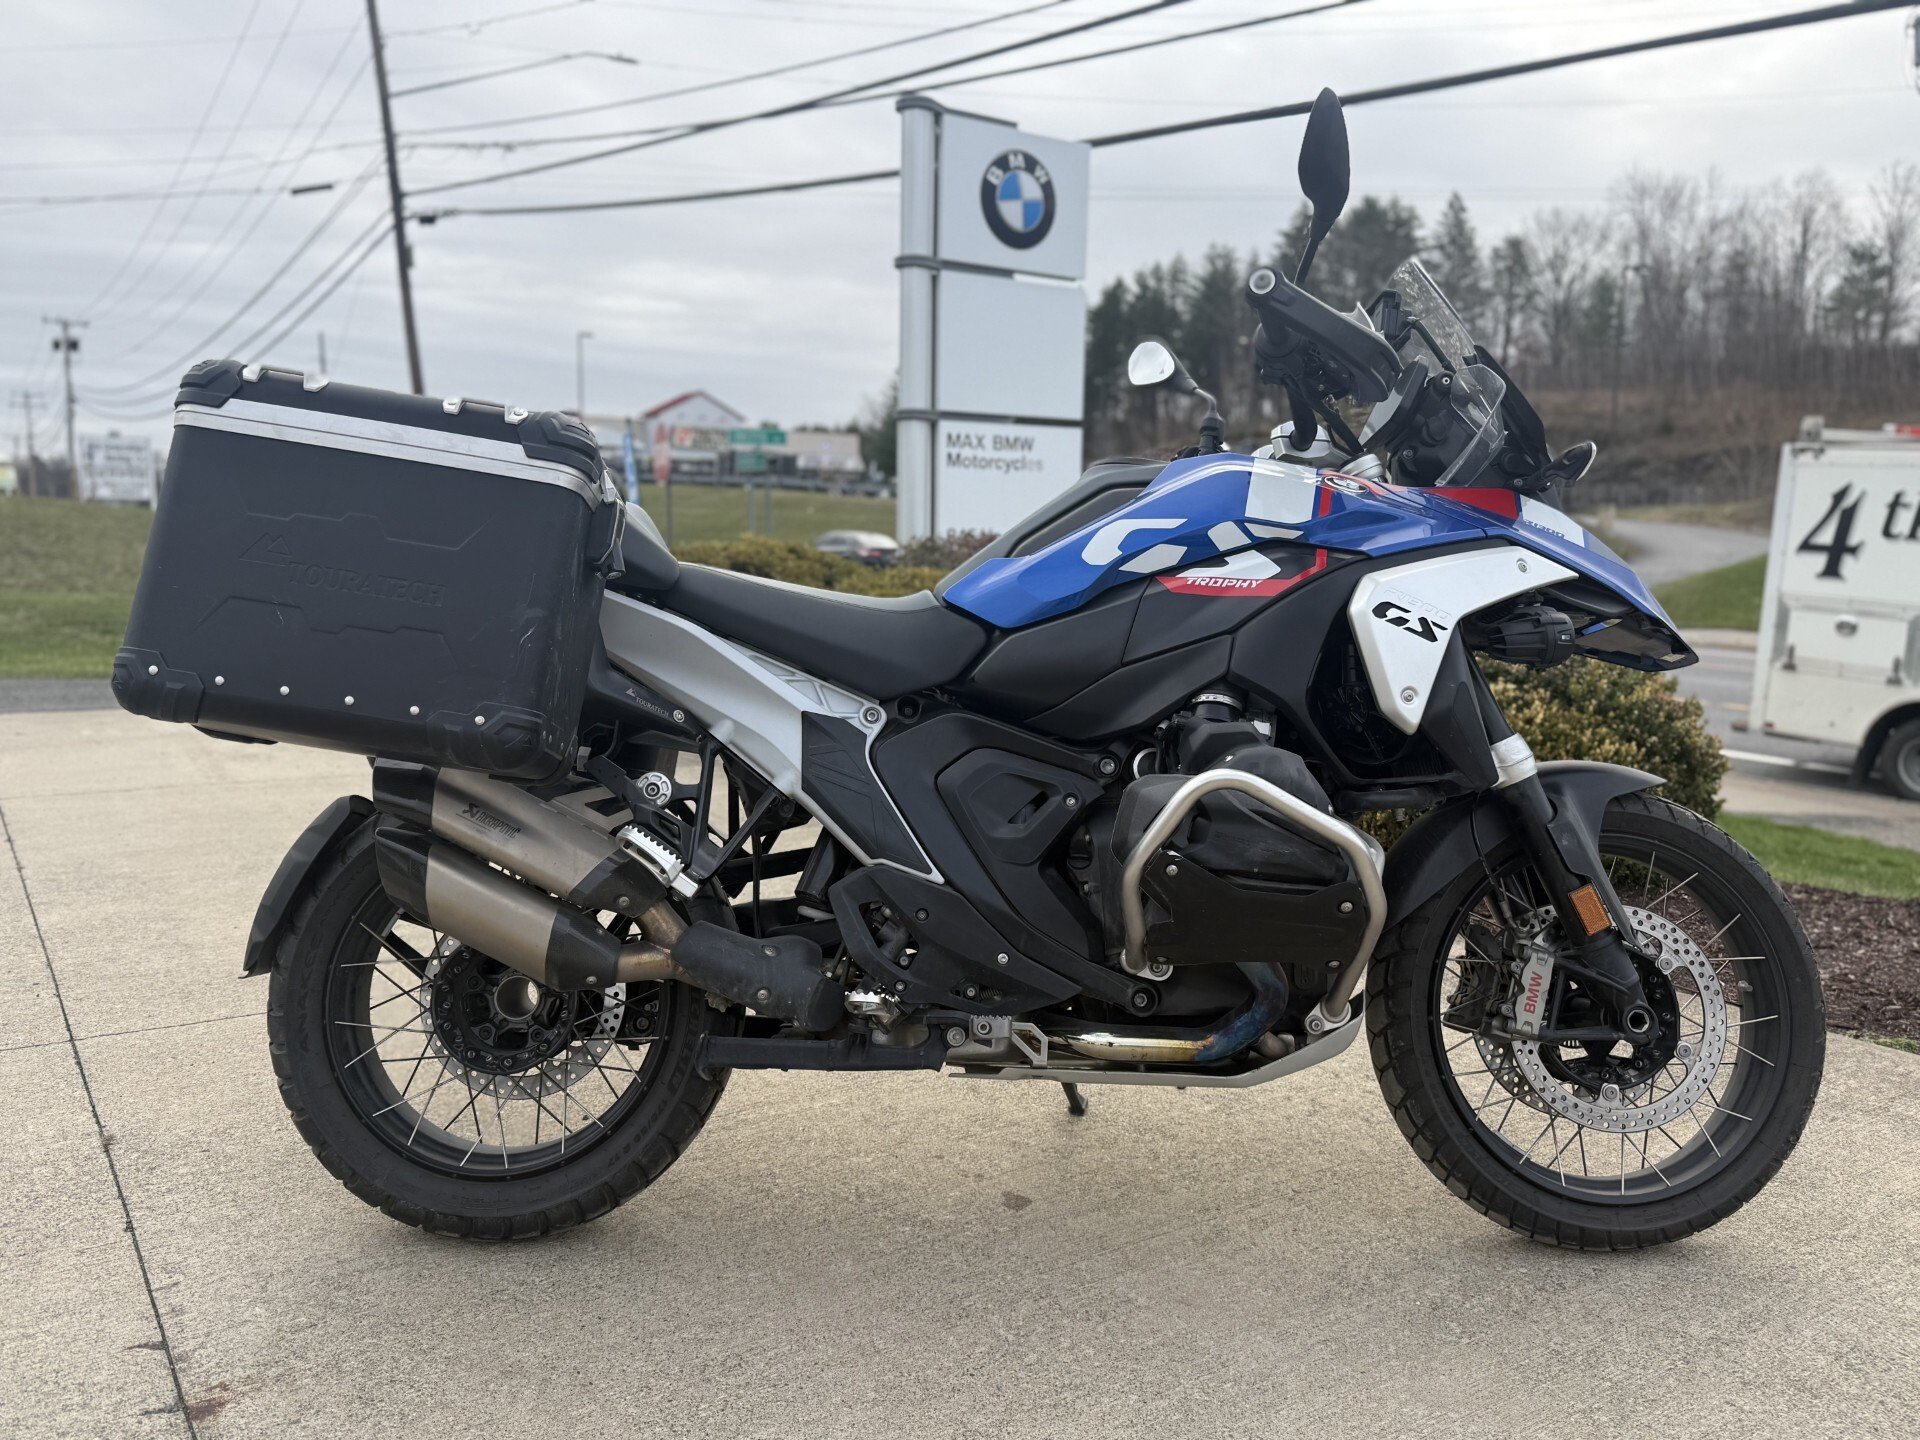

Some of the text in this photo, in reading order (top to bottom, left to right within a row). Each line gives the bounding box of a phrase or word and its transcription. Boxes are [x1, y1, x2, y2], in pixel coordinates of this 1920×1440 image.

[986, 152, 1049, 186] BMW
[946, 432, 1035, 452] MAX BMW
[946, 452, 1045, 474] Motorcycles
[1797, 481, 1866, 580] 4
[285, 560, 447, 608] TOURATECH
[1186, 577, 1263, 589] TROPHY
[1372, 601, 1448, 643] GS
[635, 696, 669, 717] TOURATECH
[1523, 970, 1543, 1014] BMW
